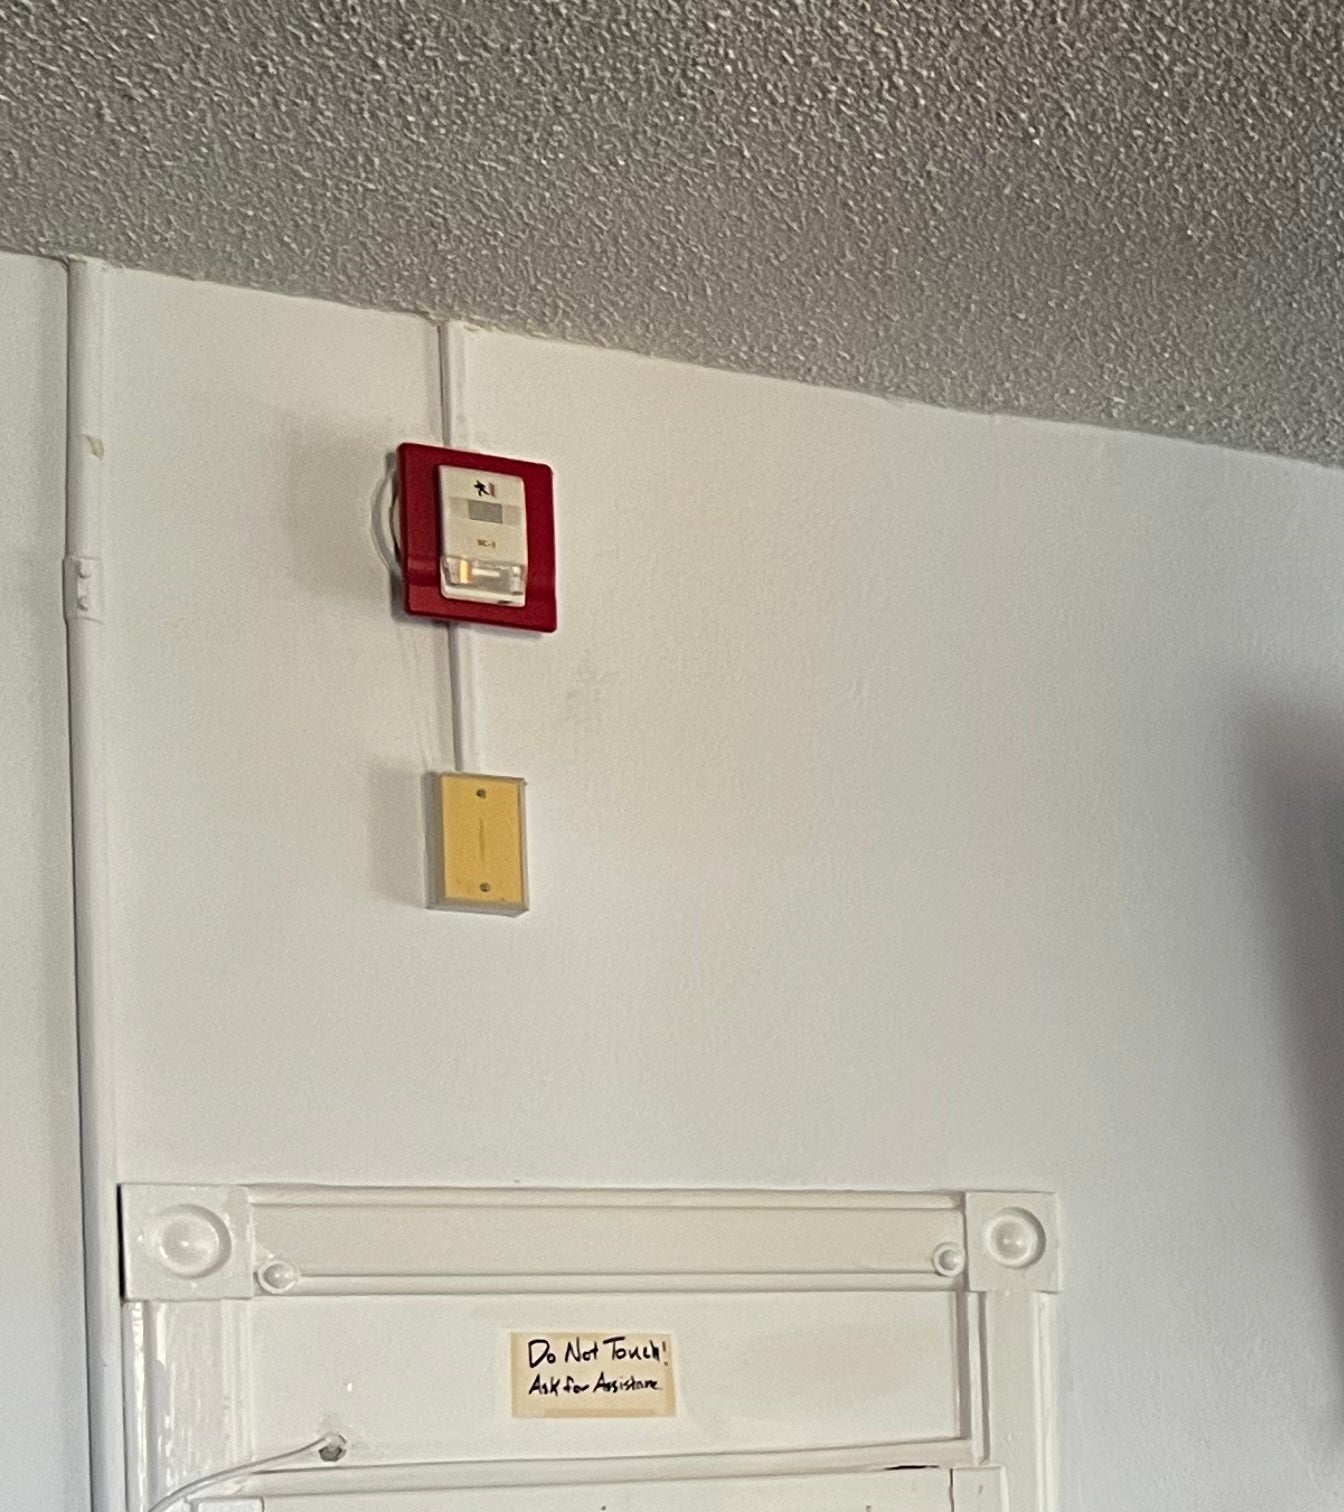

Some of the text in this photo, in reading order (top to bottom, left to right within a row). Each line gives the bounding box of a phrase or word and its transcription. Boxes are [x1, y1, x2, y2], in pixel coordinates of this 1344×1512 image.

[528, 1336, 669, 1368] Do Not Touch!
[528, 1373, 560, 1397] Ask
[563, 1375, 589, 1394] for
